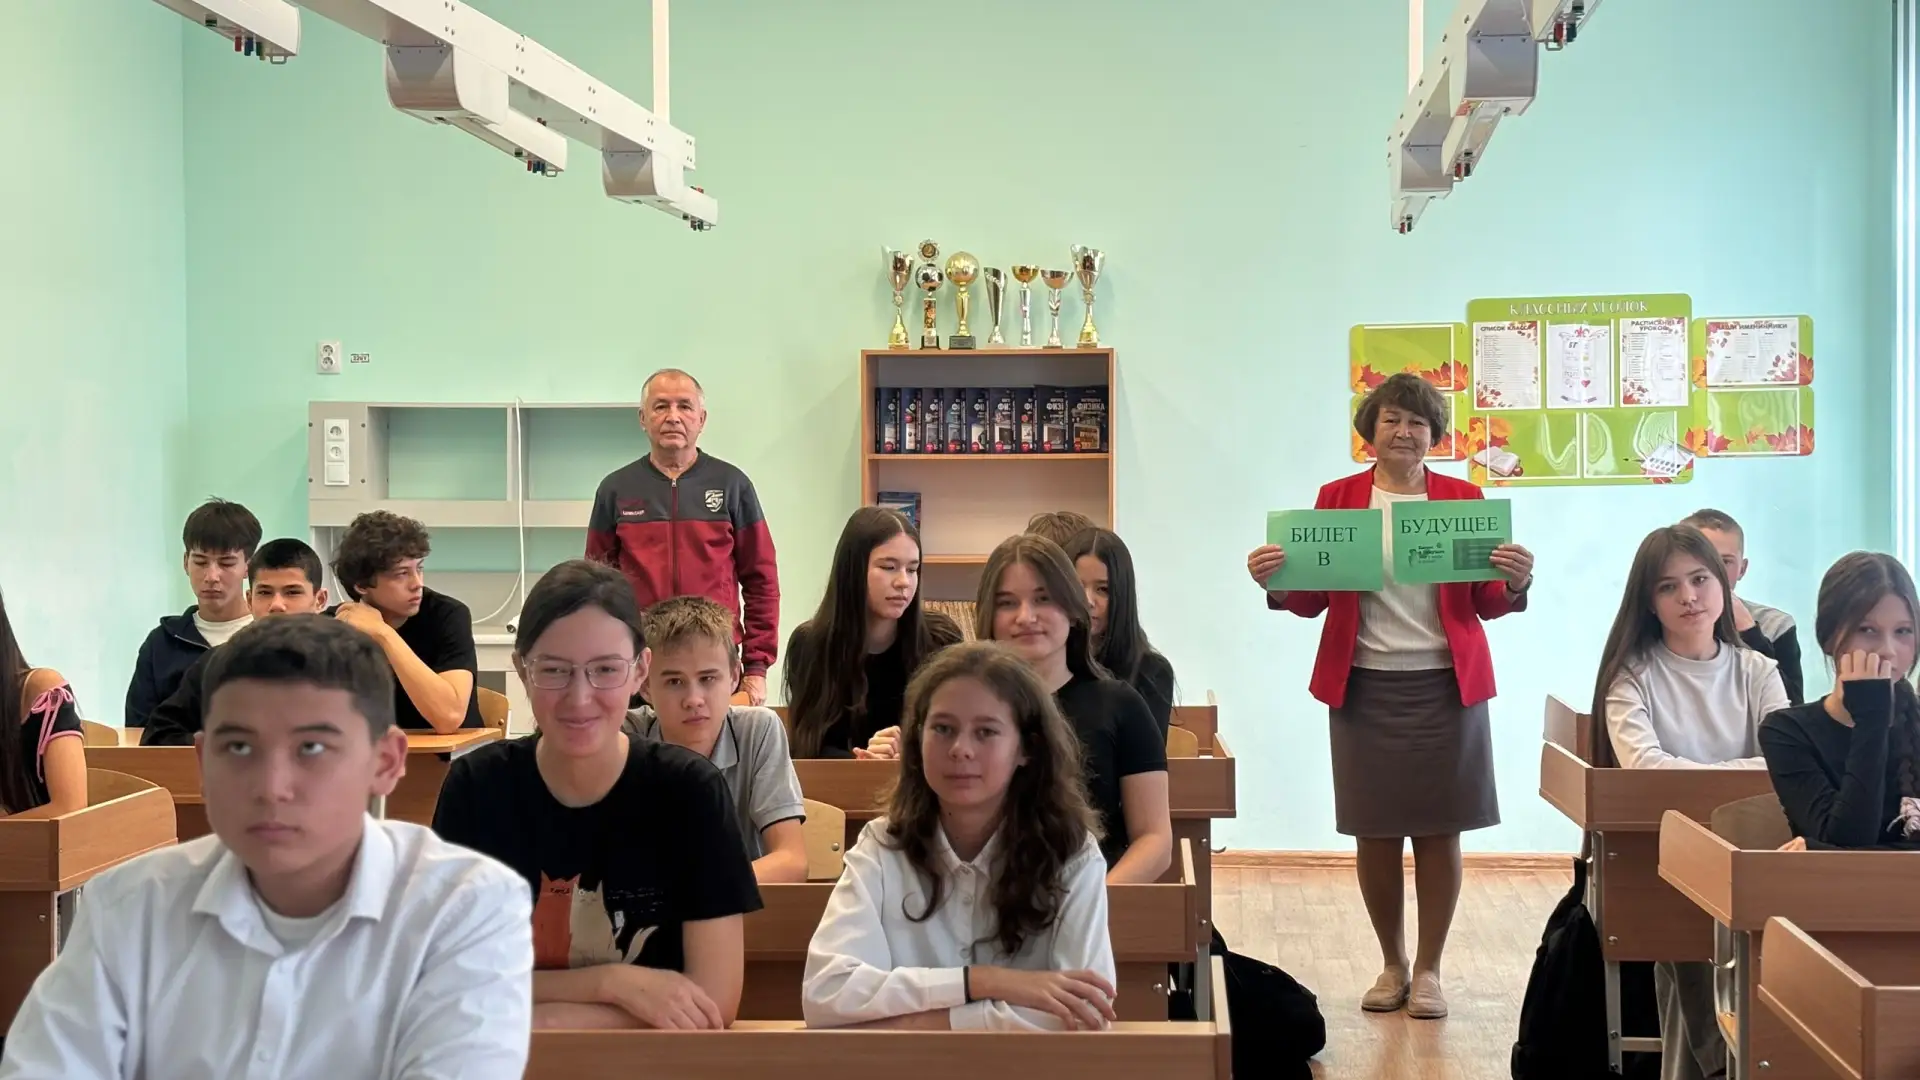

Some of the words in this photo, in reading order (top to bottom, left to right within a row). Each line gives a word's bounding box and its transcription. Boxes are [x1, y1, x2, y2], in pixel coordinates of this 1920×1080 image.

[1509, 300, 1588, 316] КЛАССНЫЙ
[1592, 299, 1649, 315] УГОЛОК
[1400, 516, 1499, 535] БУДУЩЕЕ
[1290, 527, 1358, 543] БИЛЕТ
[1318, 551, 1331, 566] В
